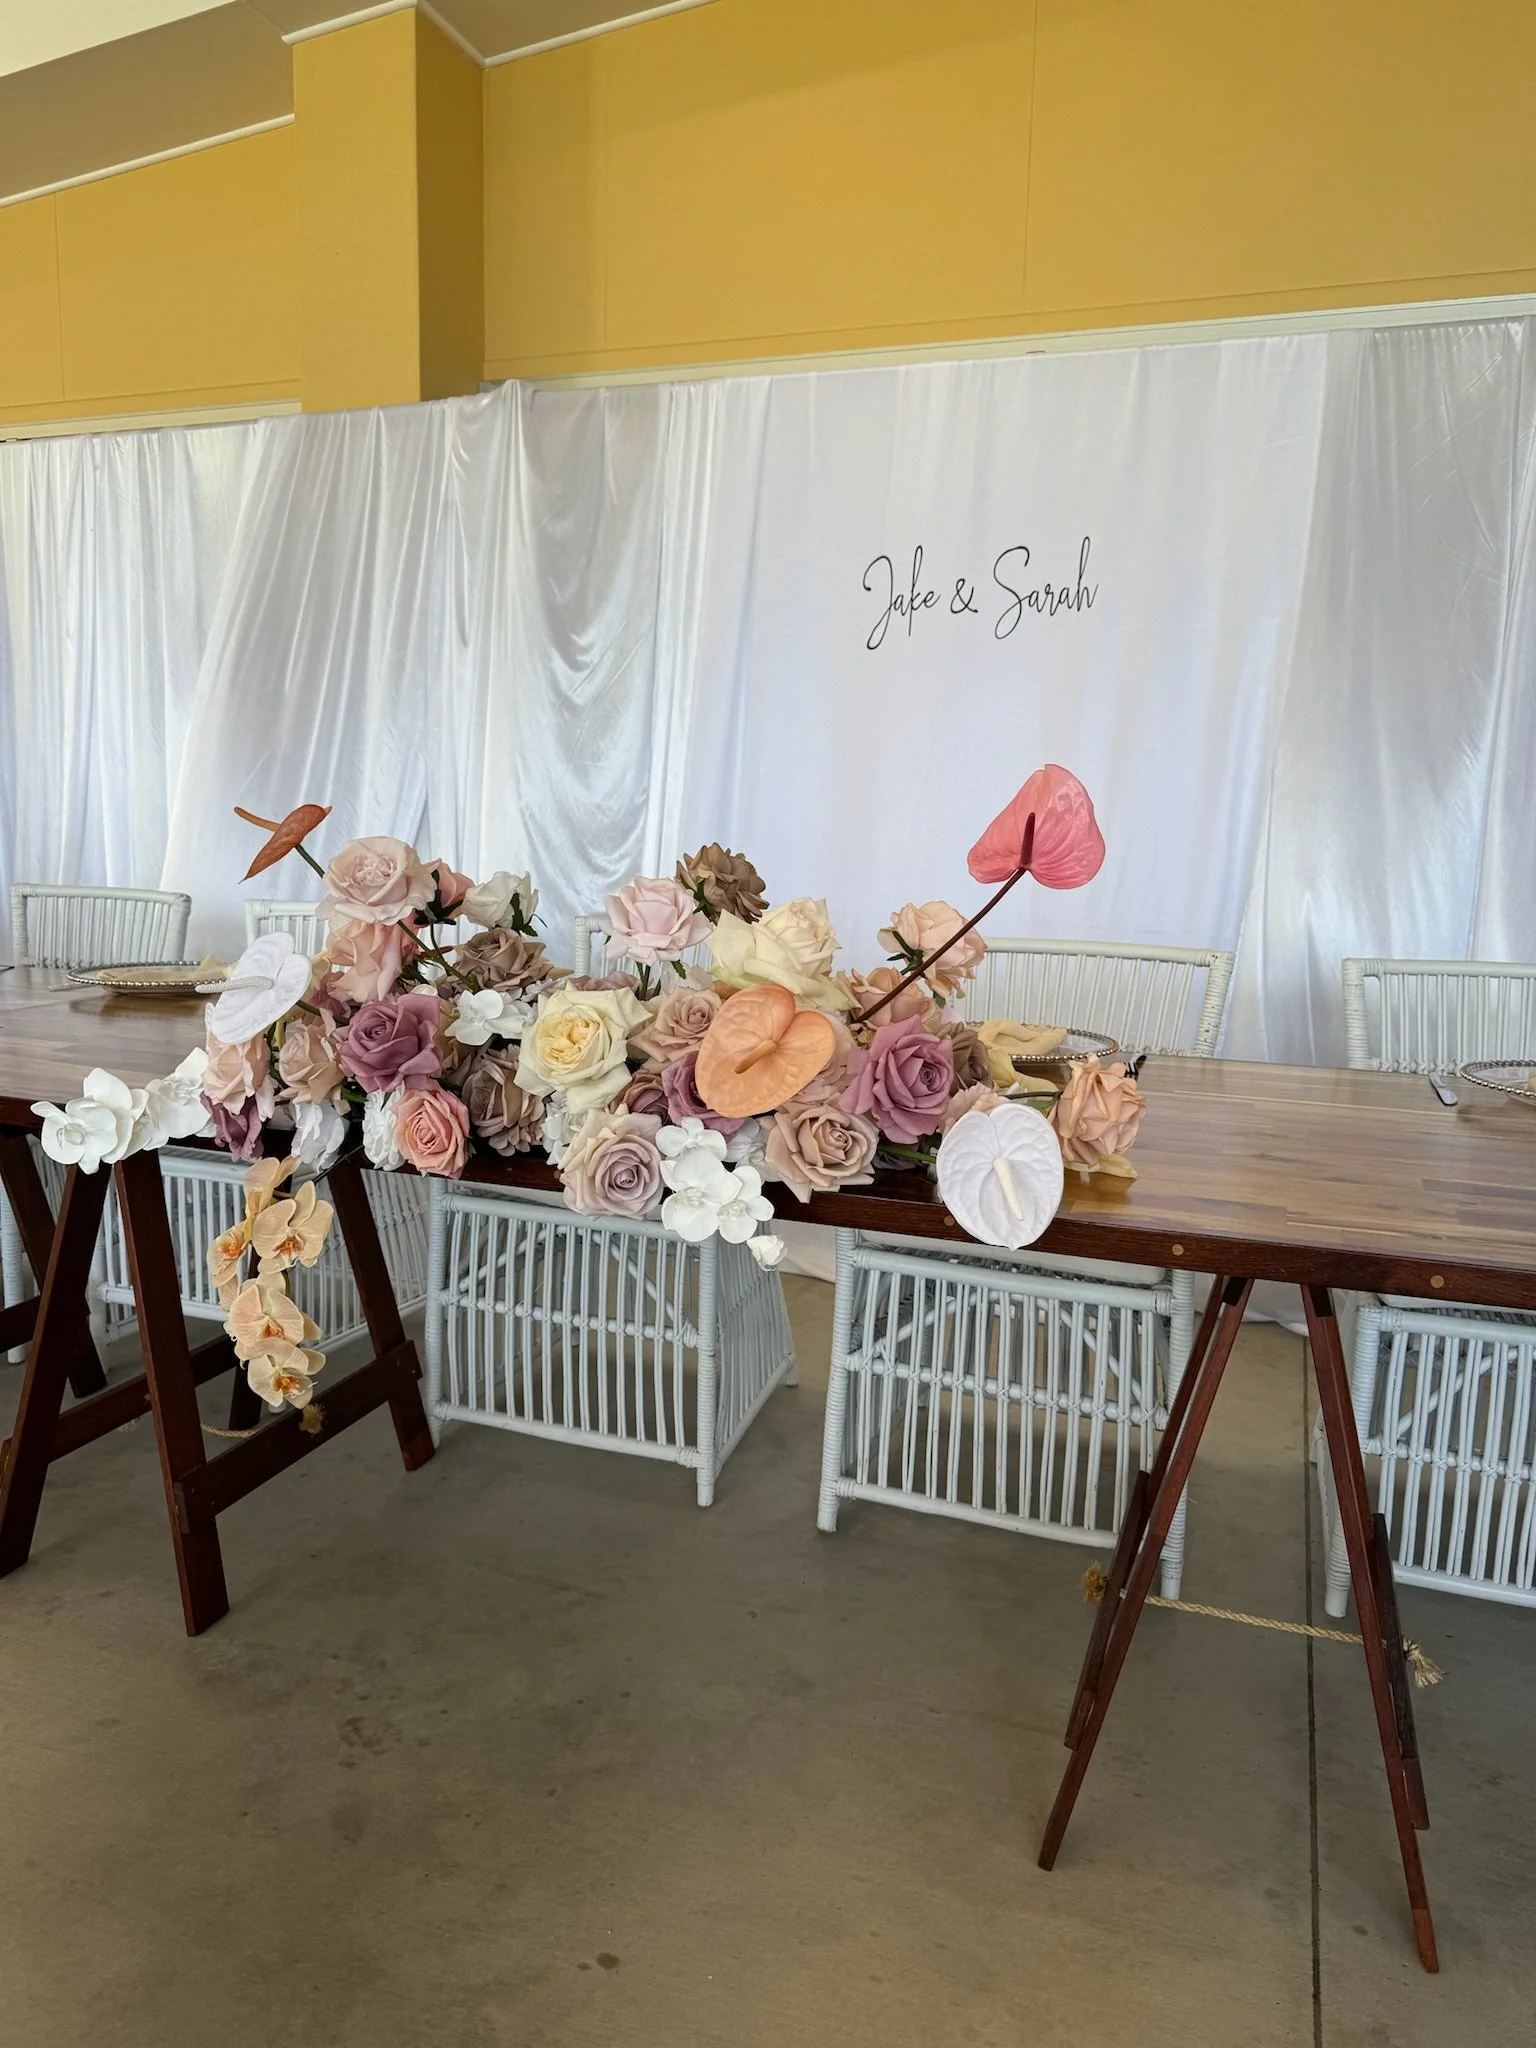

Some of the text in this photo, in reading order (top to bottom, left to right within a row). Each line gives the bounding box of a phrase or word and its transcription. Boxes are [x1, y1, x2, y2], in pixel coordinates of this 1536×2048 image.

[862, 536, 1099, 650] Jake & Sarah
